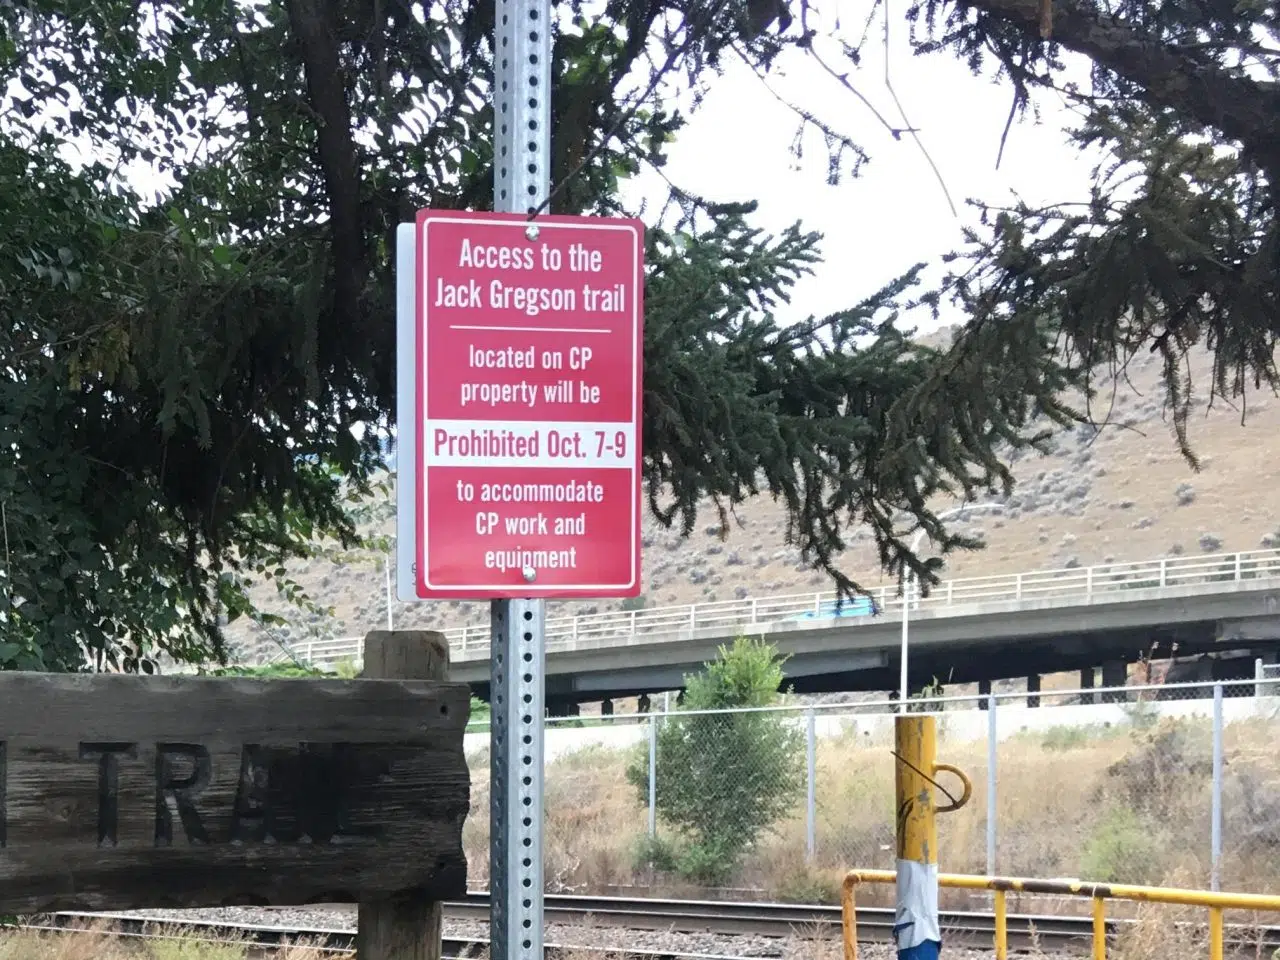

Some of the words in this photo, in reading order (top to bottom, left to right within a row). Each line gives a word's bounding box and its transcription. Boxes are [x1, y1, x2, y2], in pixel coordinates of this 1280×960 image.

[459, 238, 534, 270] Access
[540, 243, 562, 271] to
[568, 243, 602, 272] the
[434, 277, 482, 308] Jack
[489, 279, 576, 316] Gregson
[582, 283, 625, 312] trail
[469, 344, 535, 369] located
[542, 350, 562, 369] on
[570, 346, 592, 370] CP
[460, 381, 538, 407] property
[543, 380, 573, 403] will
[580, 381, 601, 404] be
[434, 428, 539, 458] Prohibited
[547, 430, 587, 458] Oct.
[595, 431, 627, 459] 7-9
[456, 479, 474, 502] to
[480, 480, 604, 503] accommodate
[476, 511, 499, 535] CP
[505, 512, 548, 535] work
[554, 512, 586, 535] and
[484, 546, 577, 574] equipment
